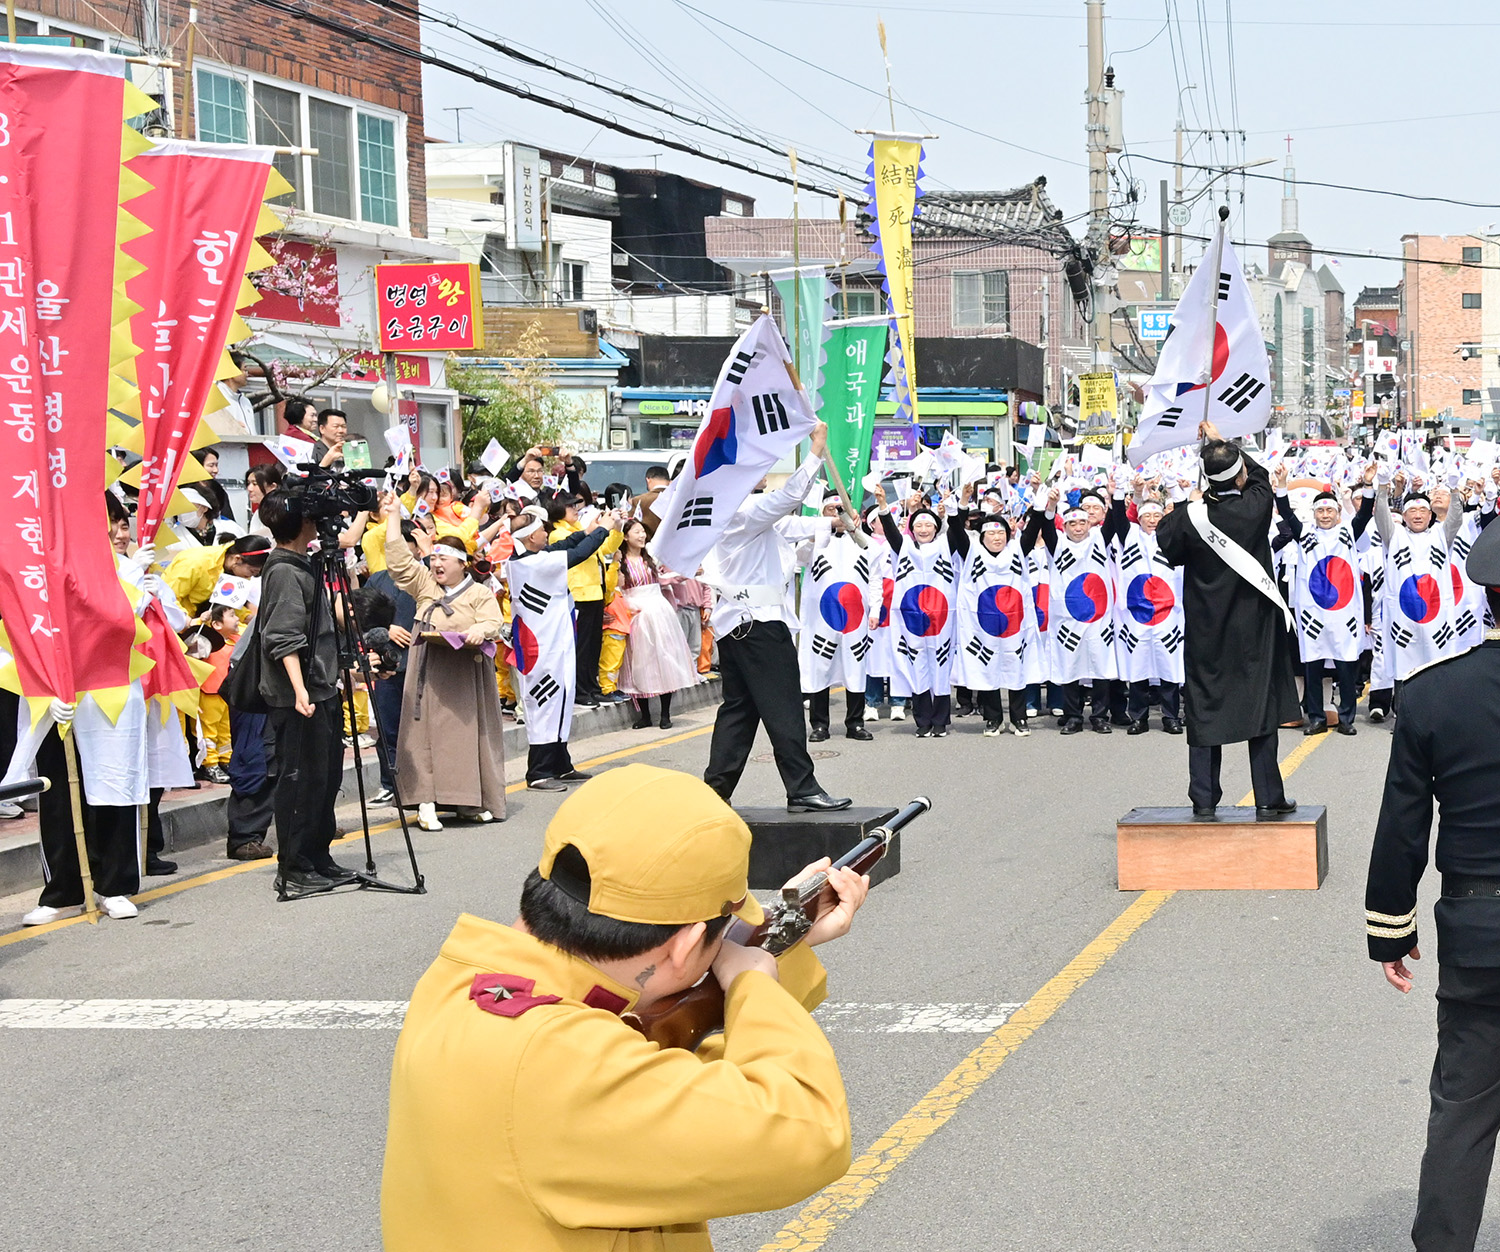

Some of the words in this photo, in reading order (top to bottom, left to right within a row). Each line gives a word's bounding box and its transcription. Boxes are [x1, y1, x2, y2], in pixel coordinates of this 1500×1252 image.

[386, 283, 428, 308] 병영
[437, 278, 465, 307] 왕
[386, 315, 468, 341] 소금구이
[845, 339, 868, 430] 애국과
